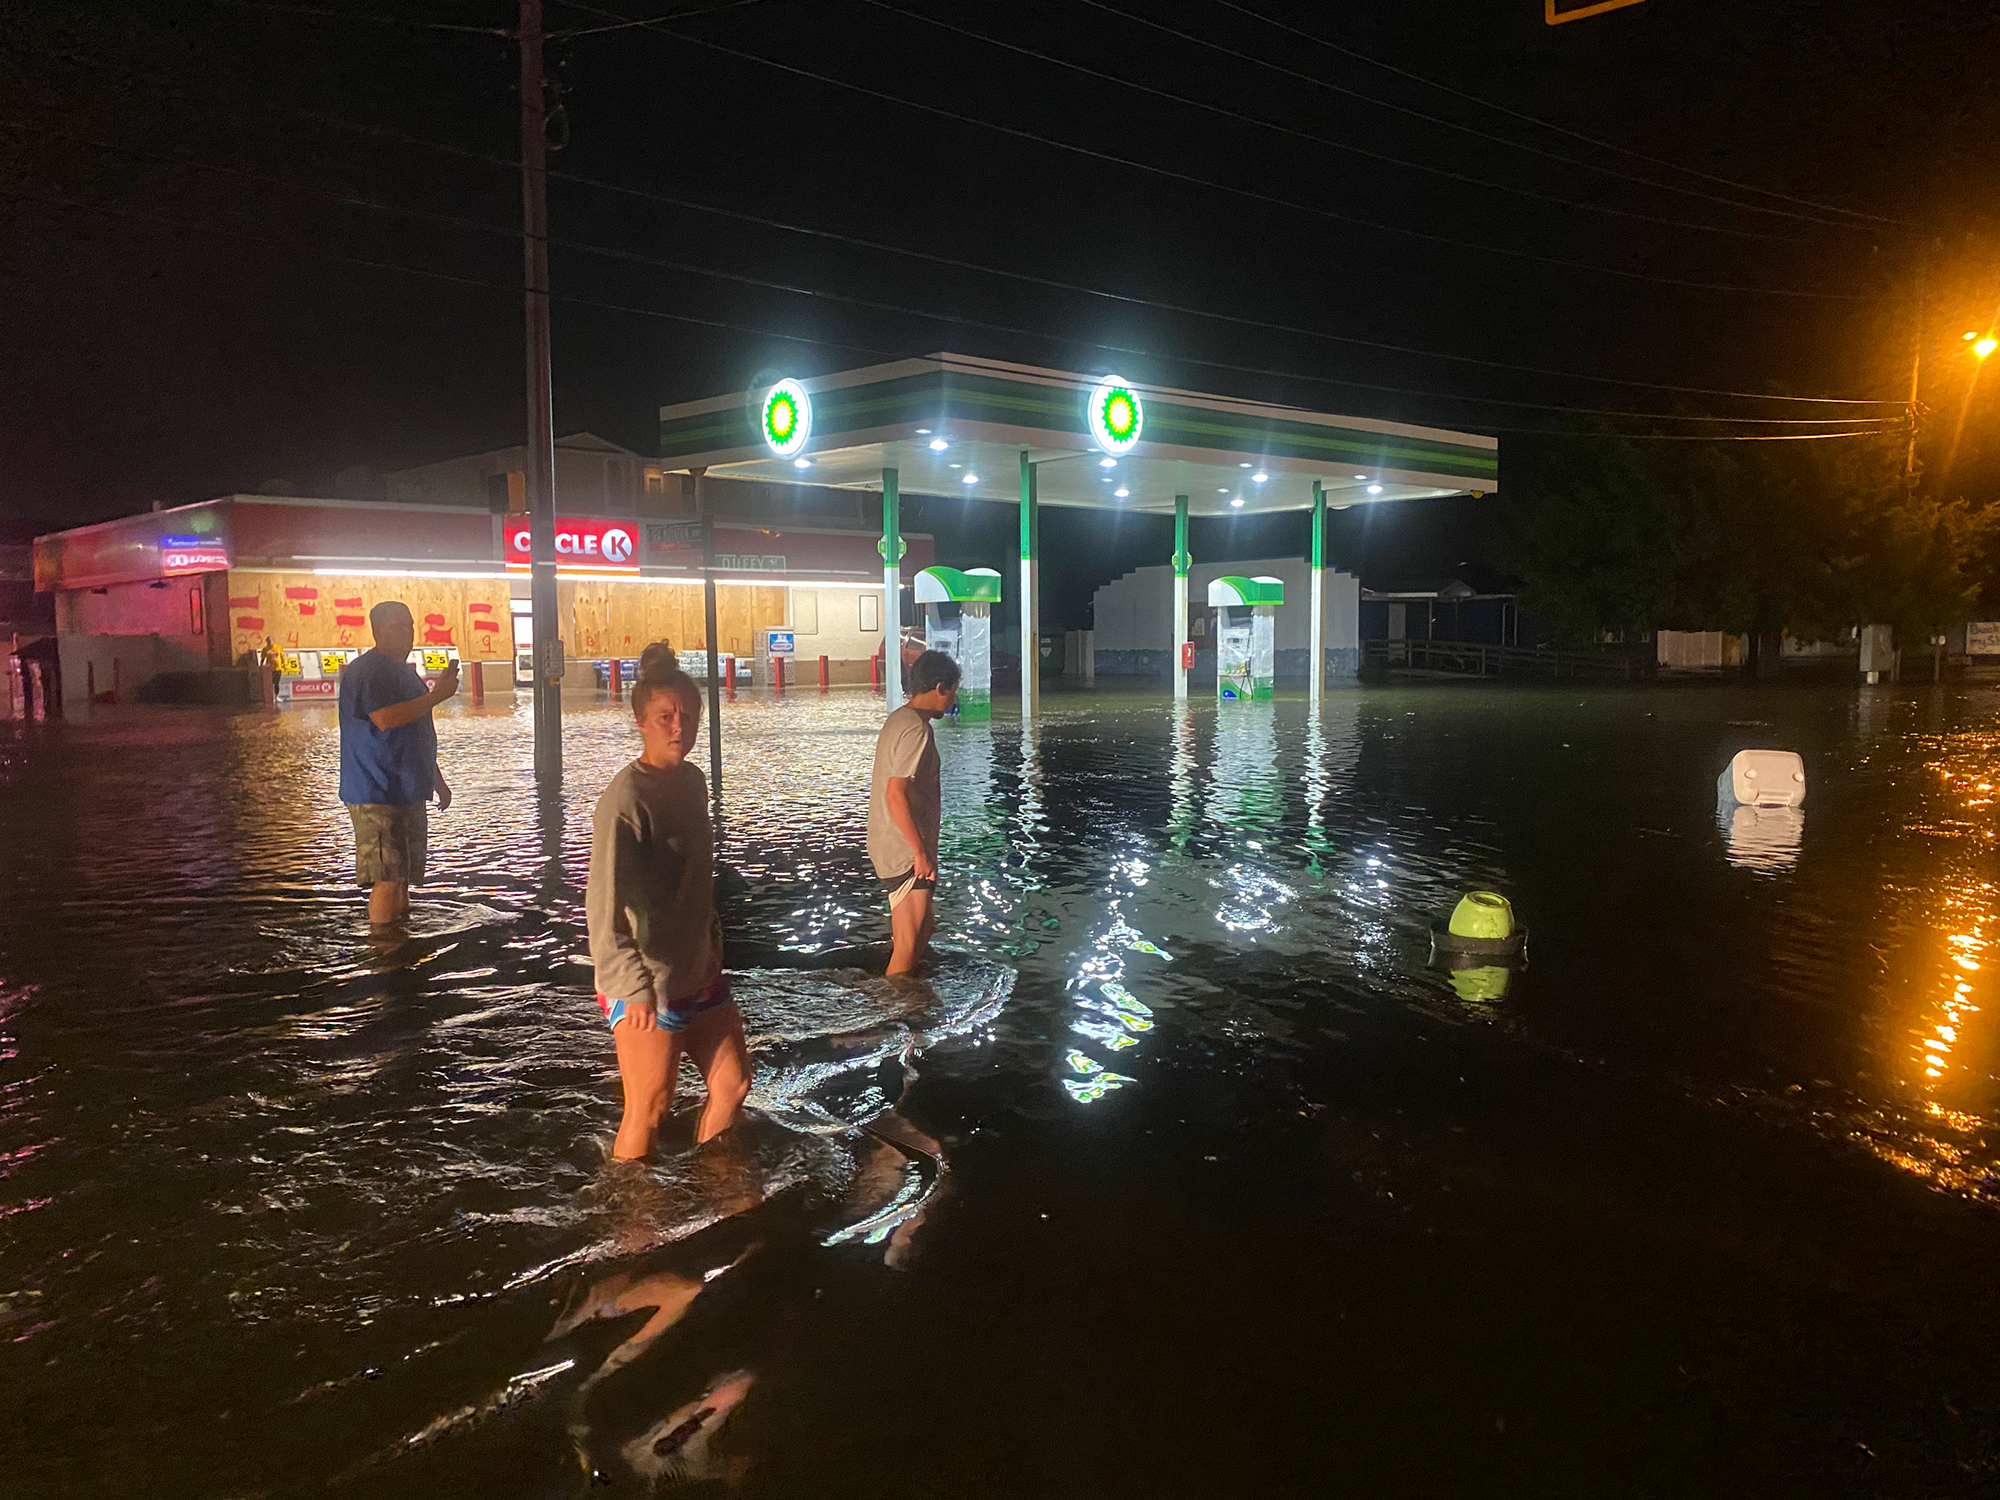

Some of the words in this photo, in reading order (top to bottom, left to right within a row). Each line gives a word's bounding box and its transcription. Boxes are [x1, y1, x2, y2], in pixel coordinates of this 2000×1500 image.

[514, 531, 598, 555] CCLE
[605, 531, 632, 561] K
[722, 557, 765, 569] DUFFY
[287, 631, 299, 648] 4
[324, 658, 331, 667] 2
[426, 656, 433, 664] 2
[295, 683, 320, 692] CIRCLE
